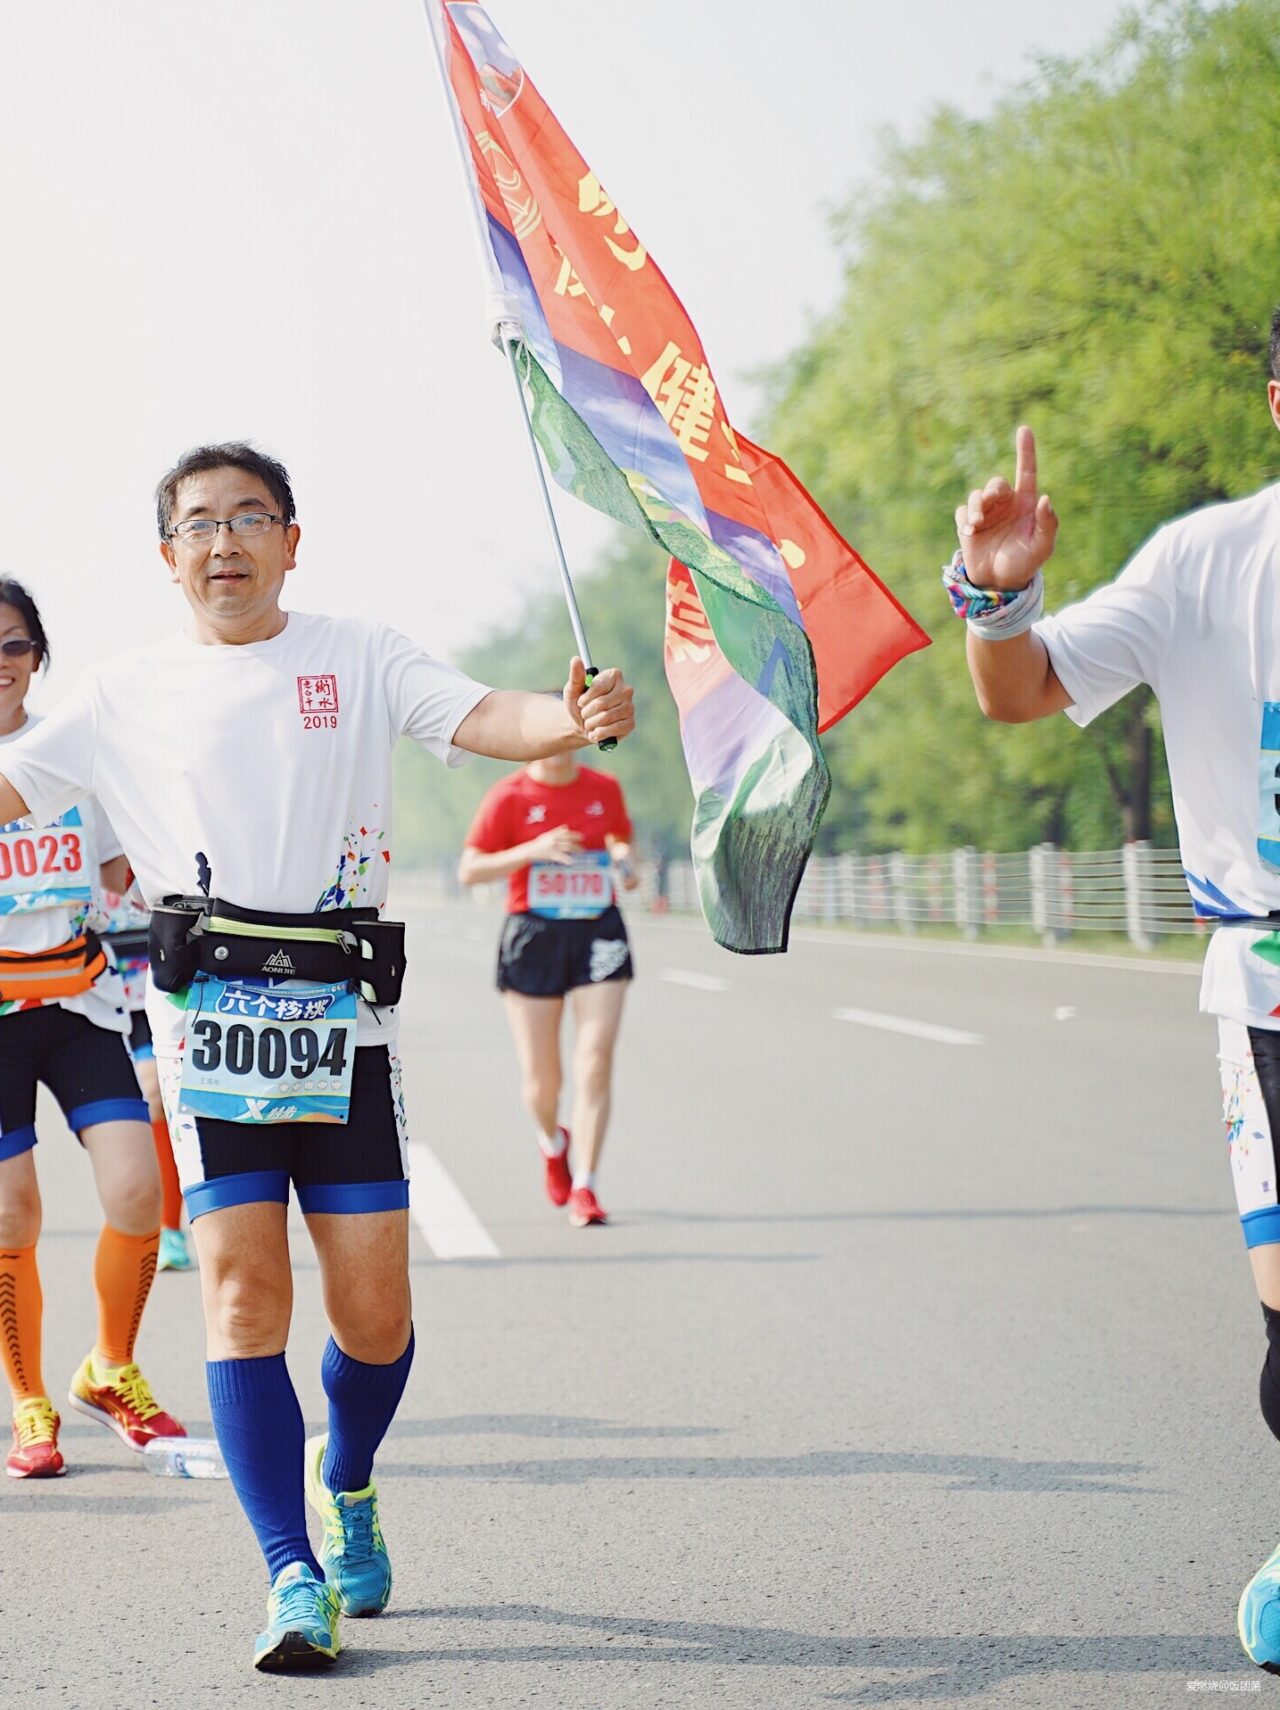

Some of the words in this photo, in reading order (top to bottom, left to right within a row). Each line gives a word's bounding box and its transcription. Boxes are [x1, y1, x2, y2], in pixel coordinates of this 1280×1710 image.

[303, 715, 337, 729] 2019
[221, 989, 329, 1021] 六个核桃
[192, 1019, 348, 1080] 30094
